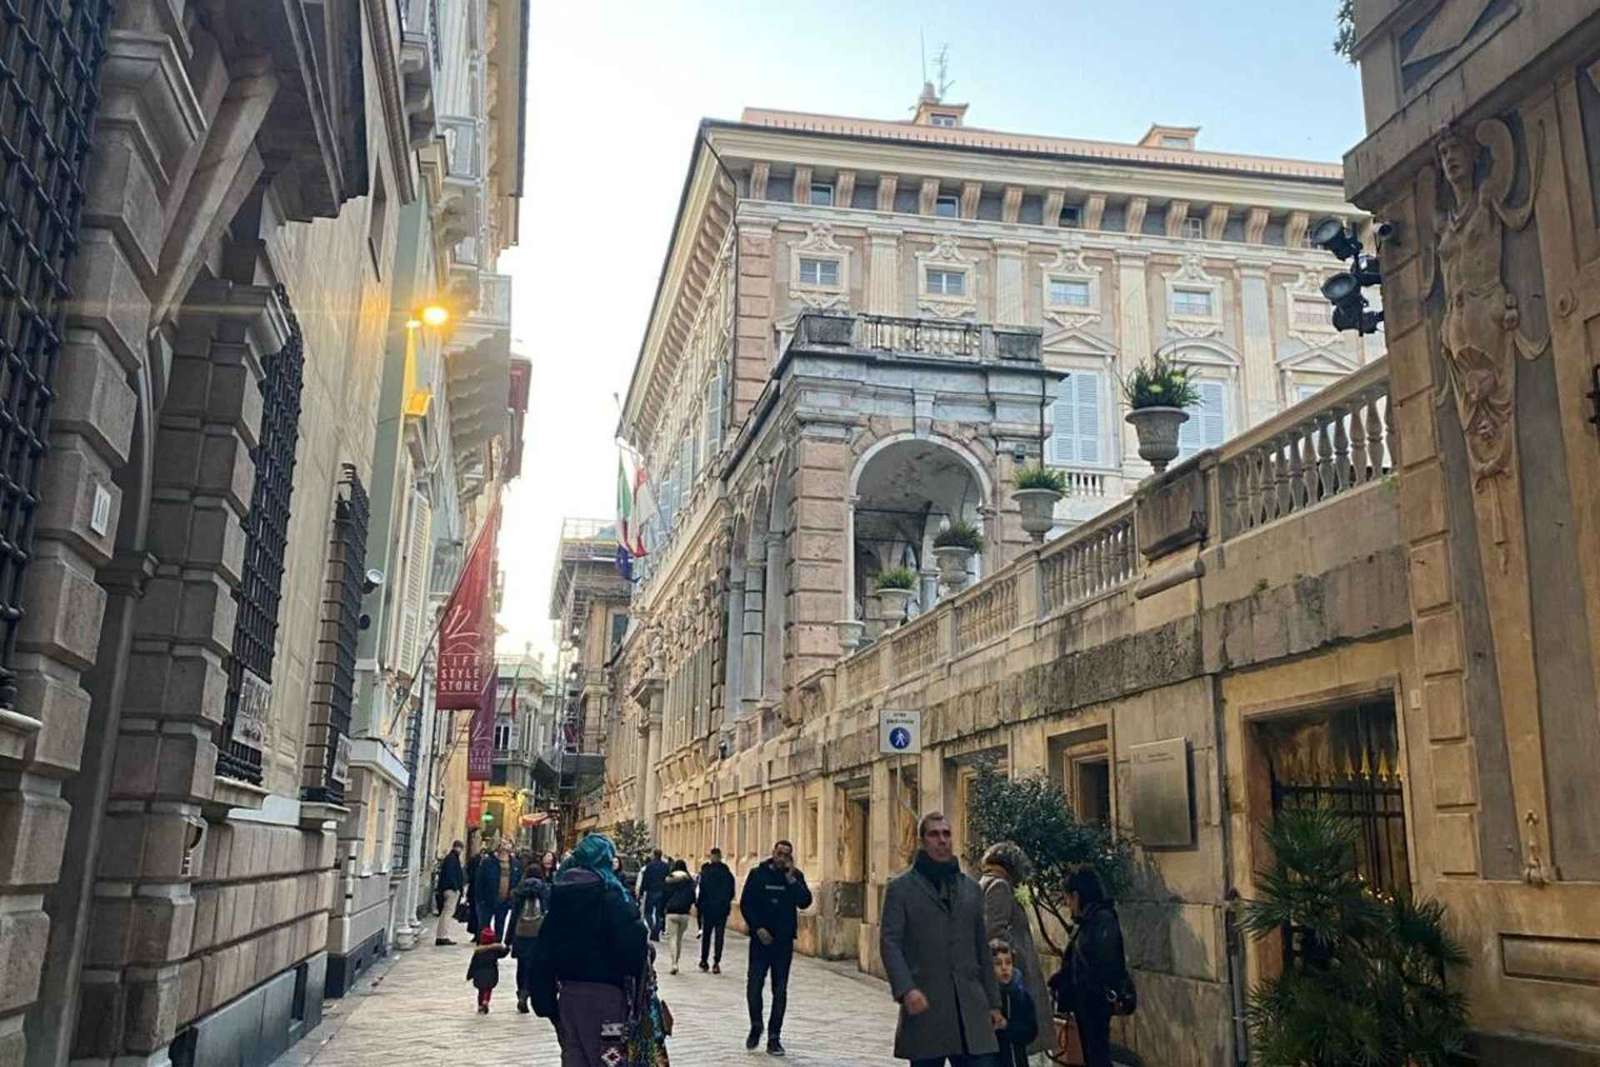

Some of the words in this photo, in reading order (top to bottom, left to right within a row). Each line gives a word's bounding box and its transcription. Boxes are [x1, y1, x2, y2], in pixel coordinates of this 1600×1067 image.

[441, 656, 480, 667] LIFE
[440, 669, 480, 679] STYLE
[440, 681, 480, 692] STORE
